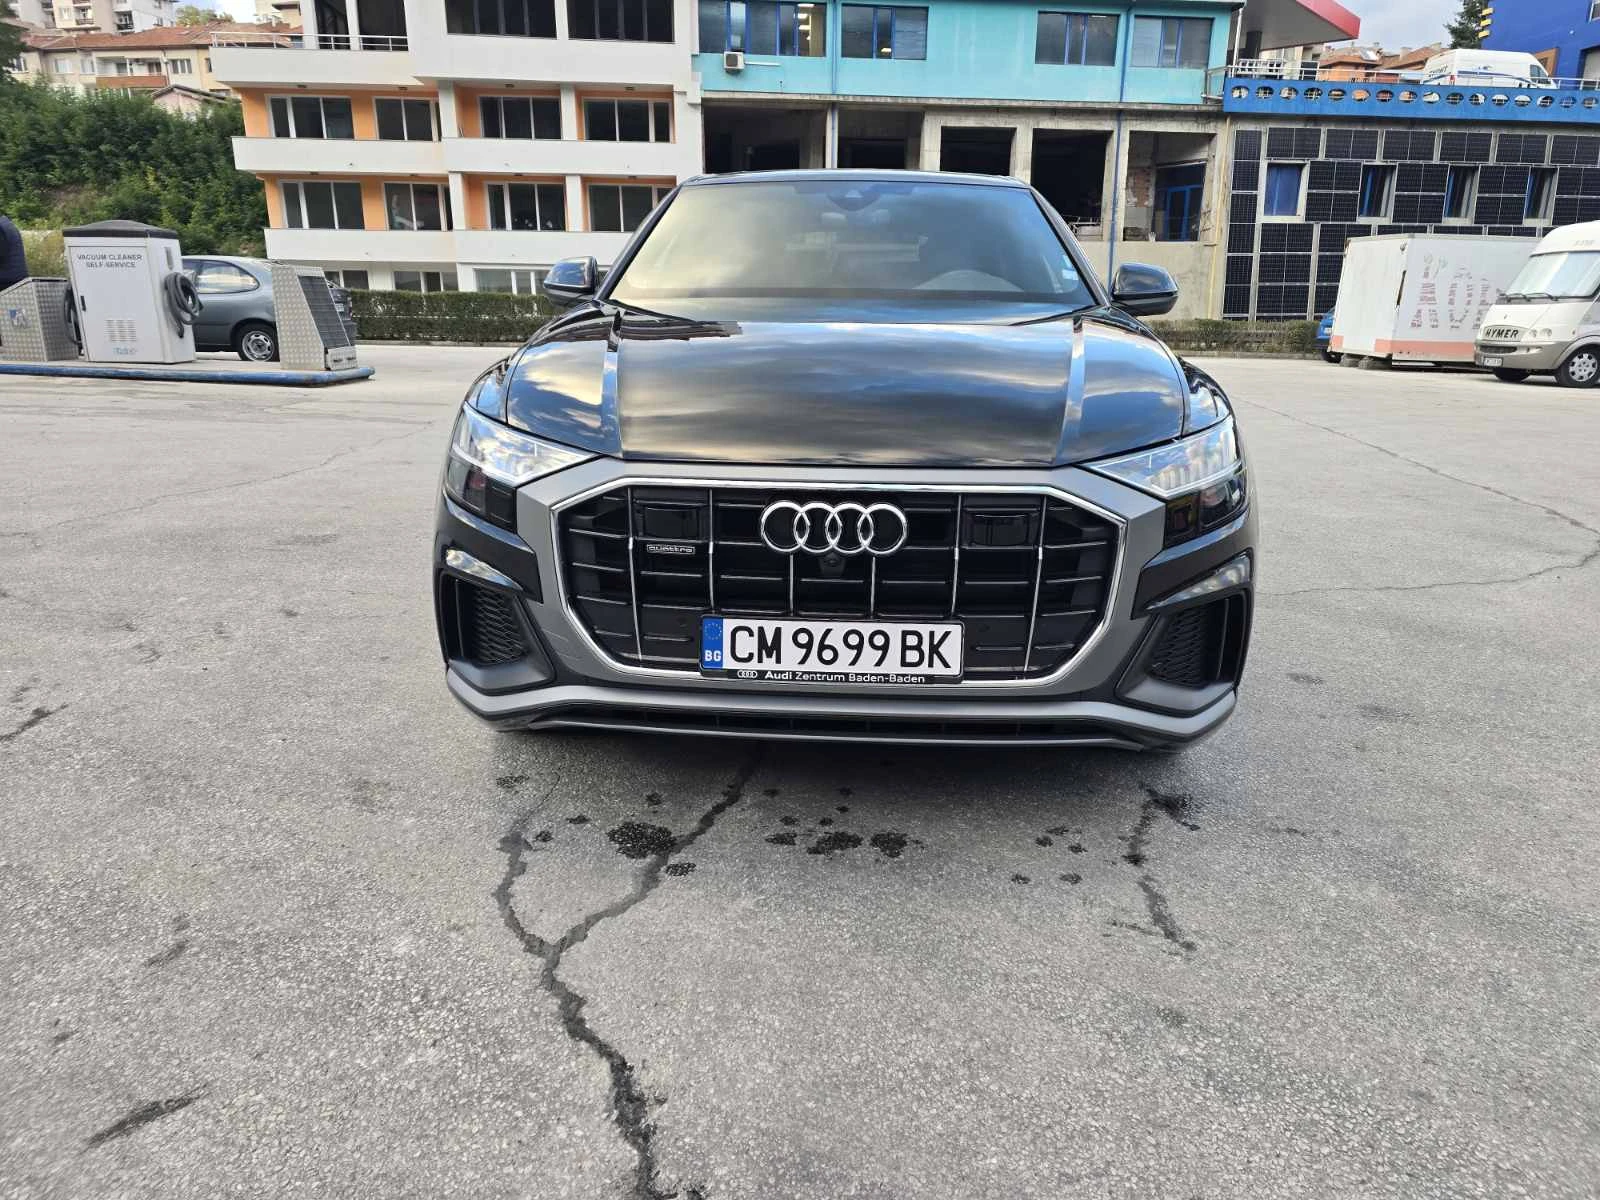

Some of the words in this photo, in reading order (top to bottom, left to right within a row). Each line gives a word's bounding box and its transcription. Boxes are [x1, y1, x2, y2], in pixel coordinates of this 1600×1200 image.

[1485, 328, 1519, 338] HYMER
[648, 543, 693, 553] quattro
[730, 625, 783, 664] CM
[791, 627, 890, 667] 9699
[900, 630, 952, 669] BK
[704, 650, 722, 662] BG
[765, 670, 792, 680] Audi
[794, 672, 845, 682] Zentrum
[849, 673, 925, 683] Baden-Baden
